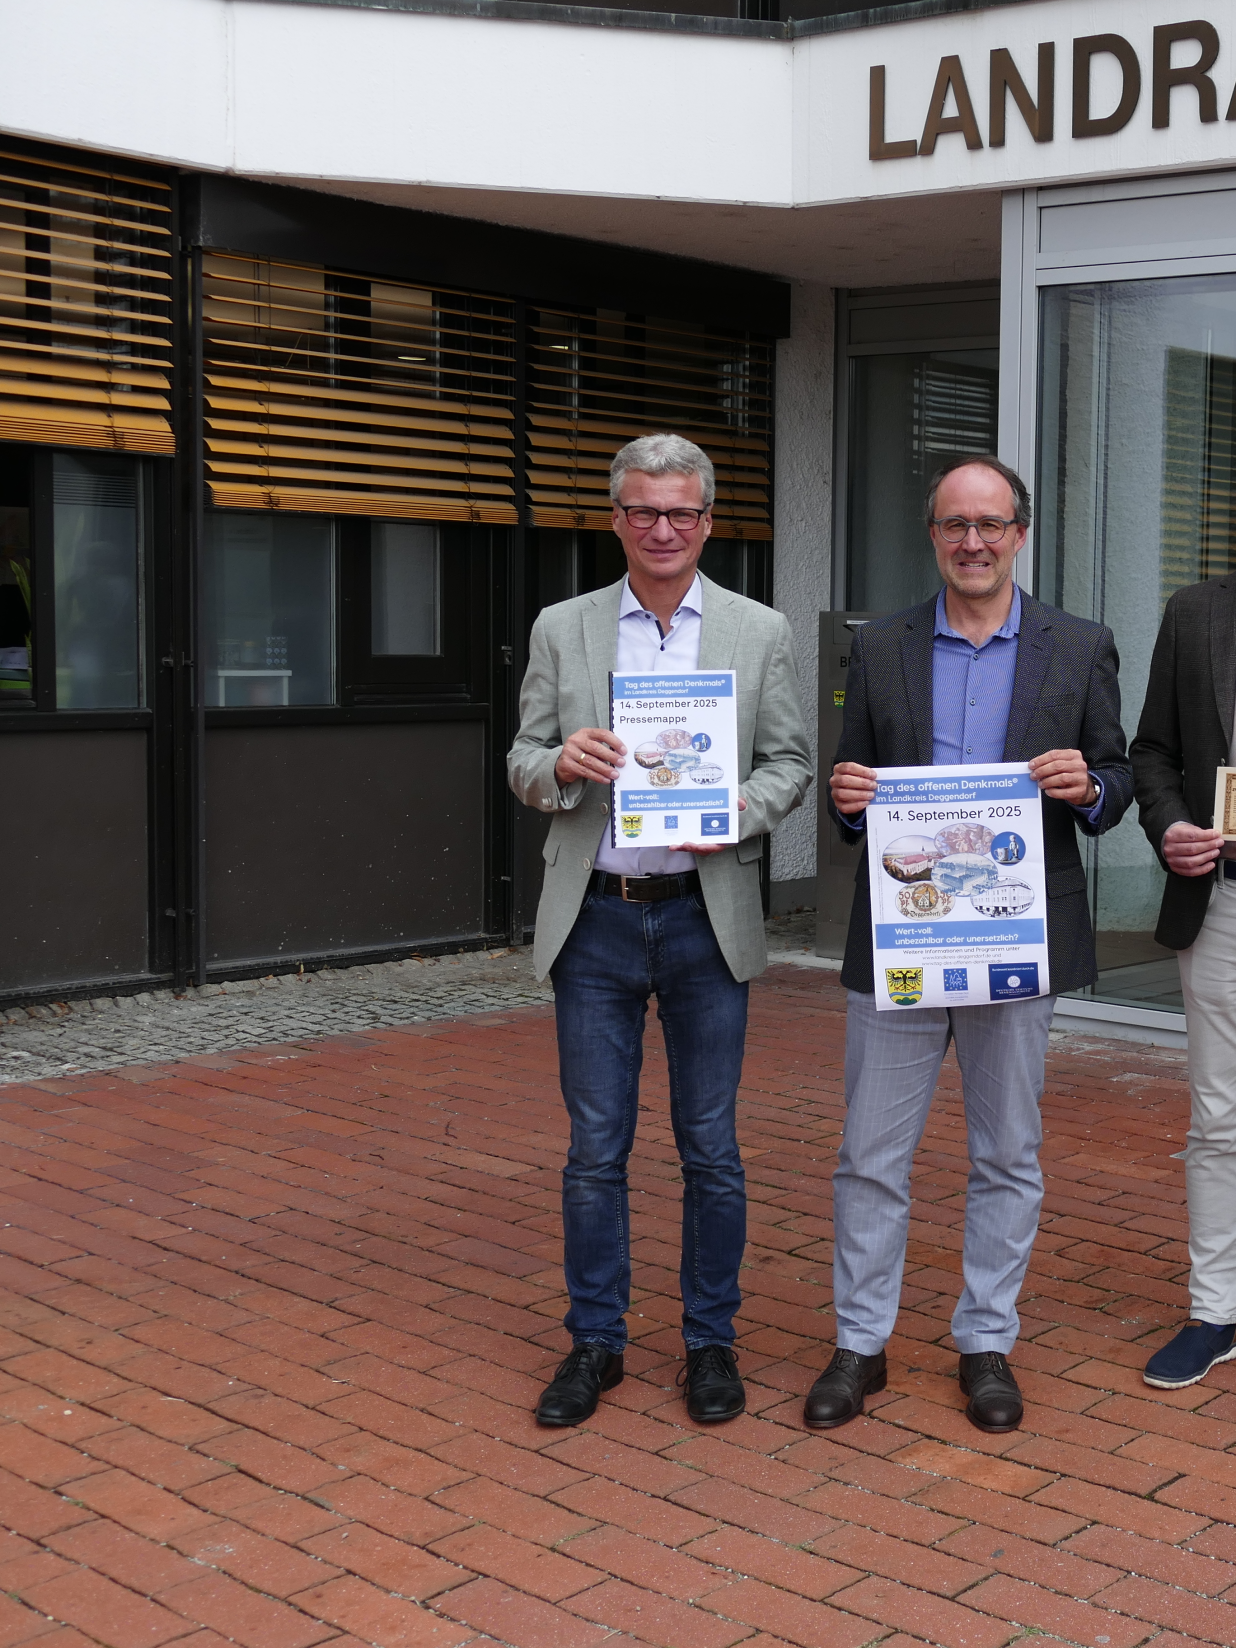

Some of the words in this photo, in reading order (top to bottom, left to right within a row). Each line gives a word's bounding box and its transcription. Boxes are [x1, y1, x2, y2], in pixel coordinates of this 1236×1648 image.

[624, 681, 638, 690] Tag
[655, 680, 682, 688] offenen
[658, 688, 689, 696] Deggendorf
[620, 701, 634, 709] 14.
[636, 699, 690, 710] September
[694, 699, 717, 708] 2025
[620, 715, 687, 725] Pressemappe
[876, 783, 894, 794] Tag
[897, 783, 915, 792] des
[918, 781, 958, 791] offenen
[628, 793, 659, 801] Wert-voll:
[876, 795, 886, 803] im
[888, 793, 926, 803] Landkreis
[928, 792, 977, 803] Deggendorf
[682, 799, 724, 807] unersetzlich?
[887, 810, 903, 822] 14.
[907, 808, 983, 823] September
[988, 805, 1022, 818] 2025
[895, 927, 933, 936] Wert-voll:
[895, 936, 944, 946] unbezahlbar
[946, 935, 964, 944] oder
[966, 933, 1018, 943] unersetzlich?
[976, 946, 1005, 954] Programm
